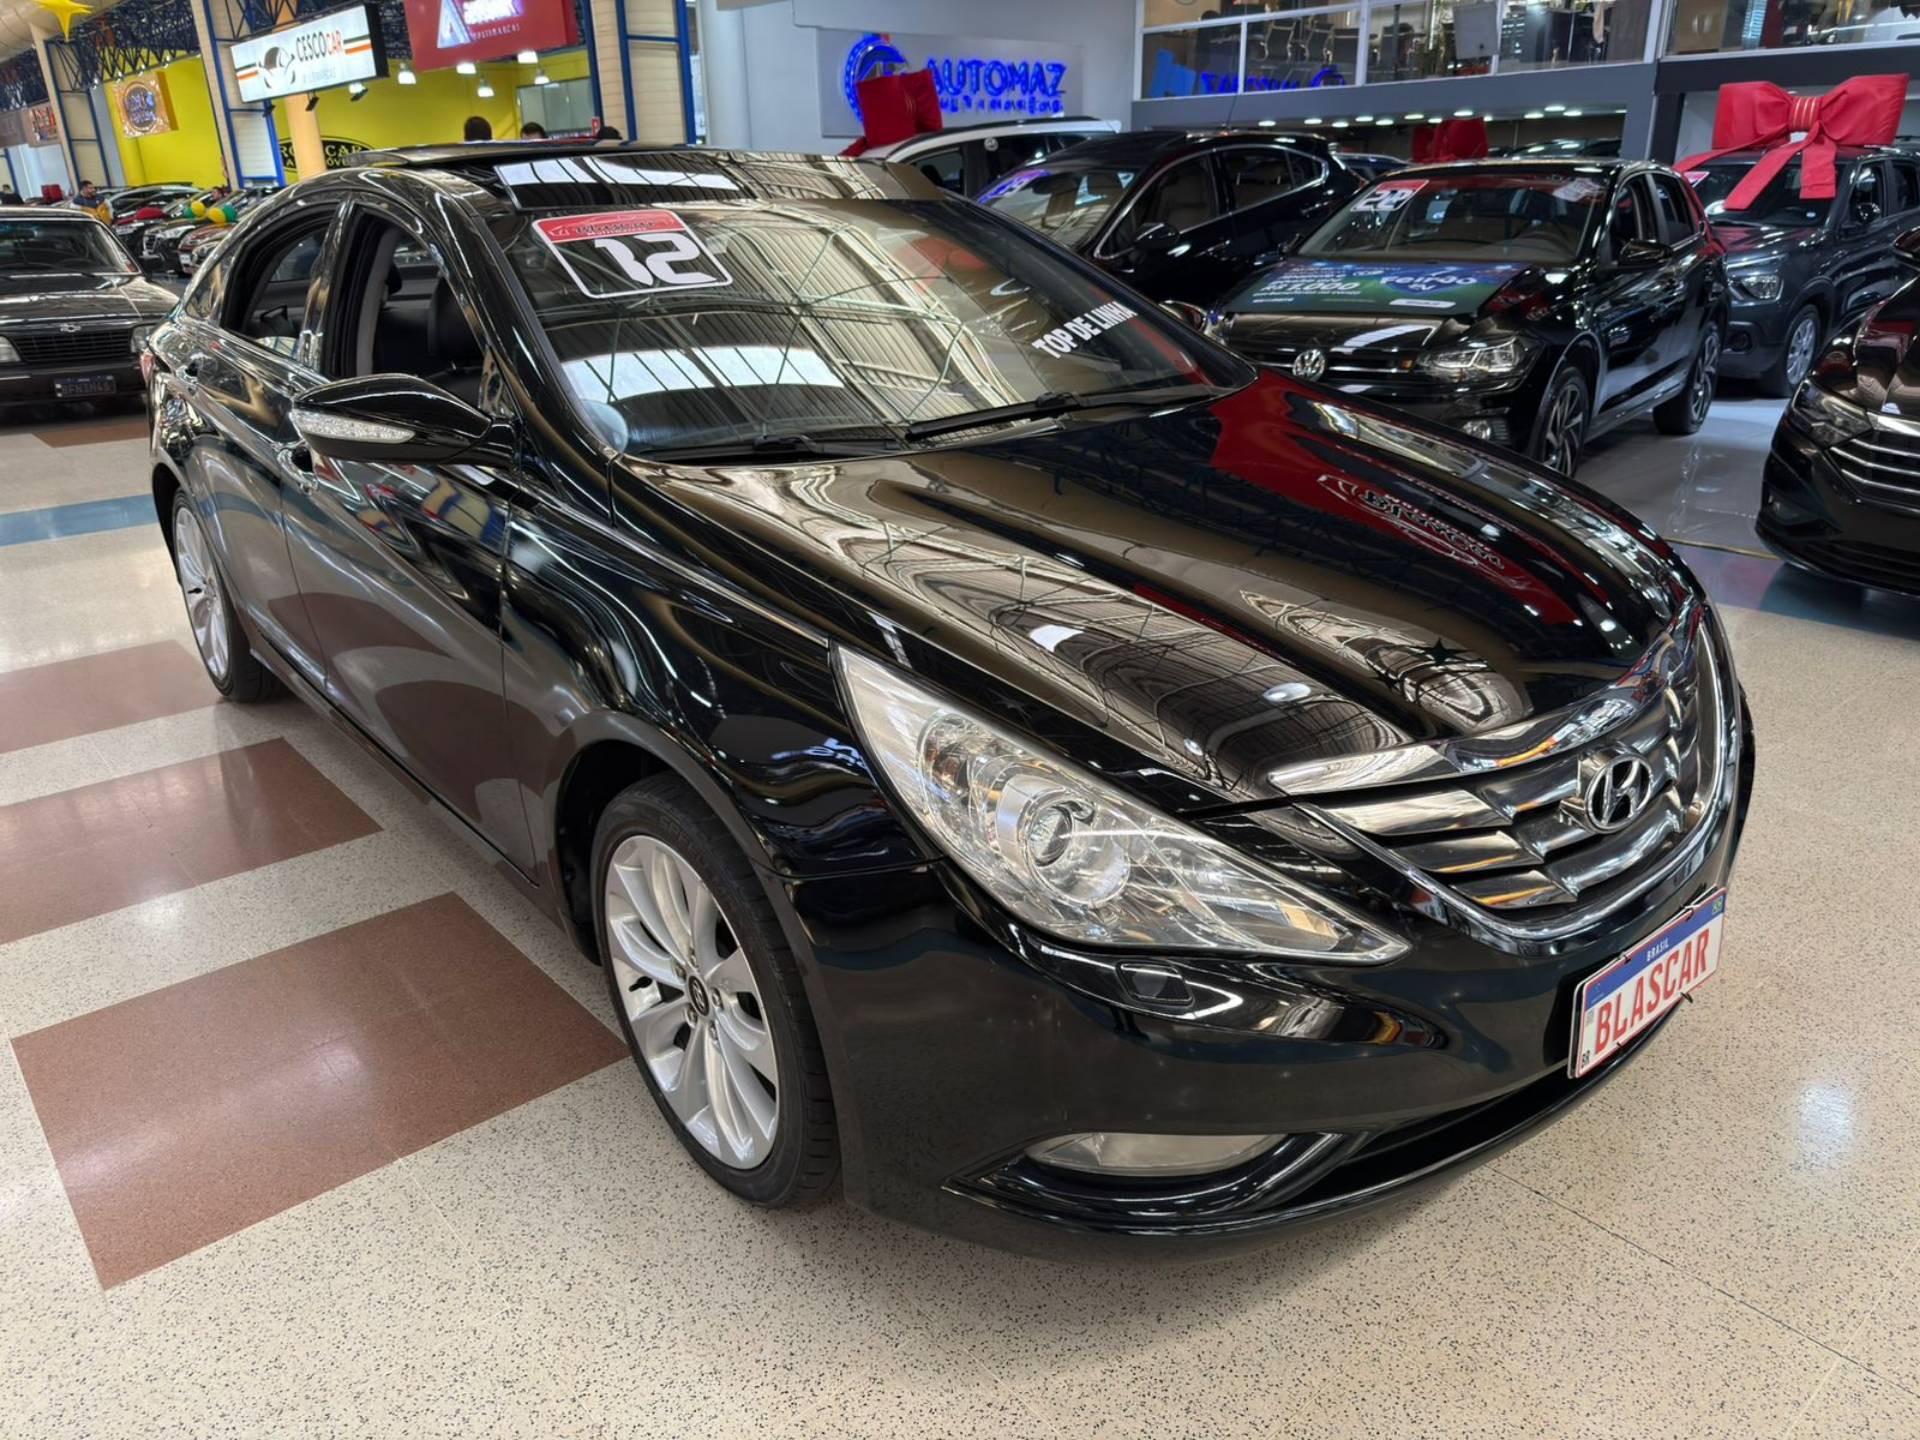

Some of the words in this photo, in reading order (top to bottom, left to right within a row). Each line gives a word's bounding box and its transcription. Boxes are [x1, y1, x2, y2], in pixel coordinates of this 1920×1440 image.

[295, 29, 342, 62] CESCOCAR
[594, 233, 718, 287] 12
[1031, 328, 1078, 360] TOP
[1063, 316, 1102, 341] DE
[1084, 300, 1138, 330] LINHA
[1646, 938, 1670, 962] BRASIL
[1594, 928, 1710, 1054] BLASCAR
